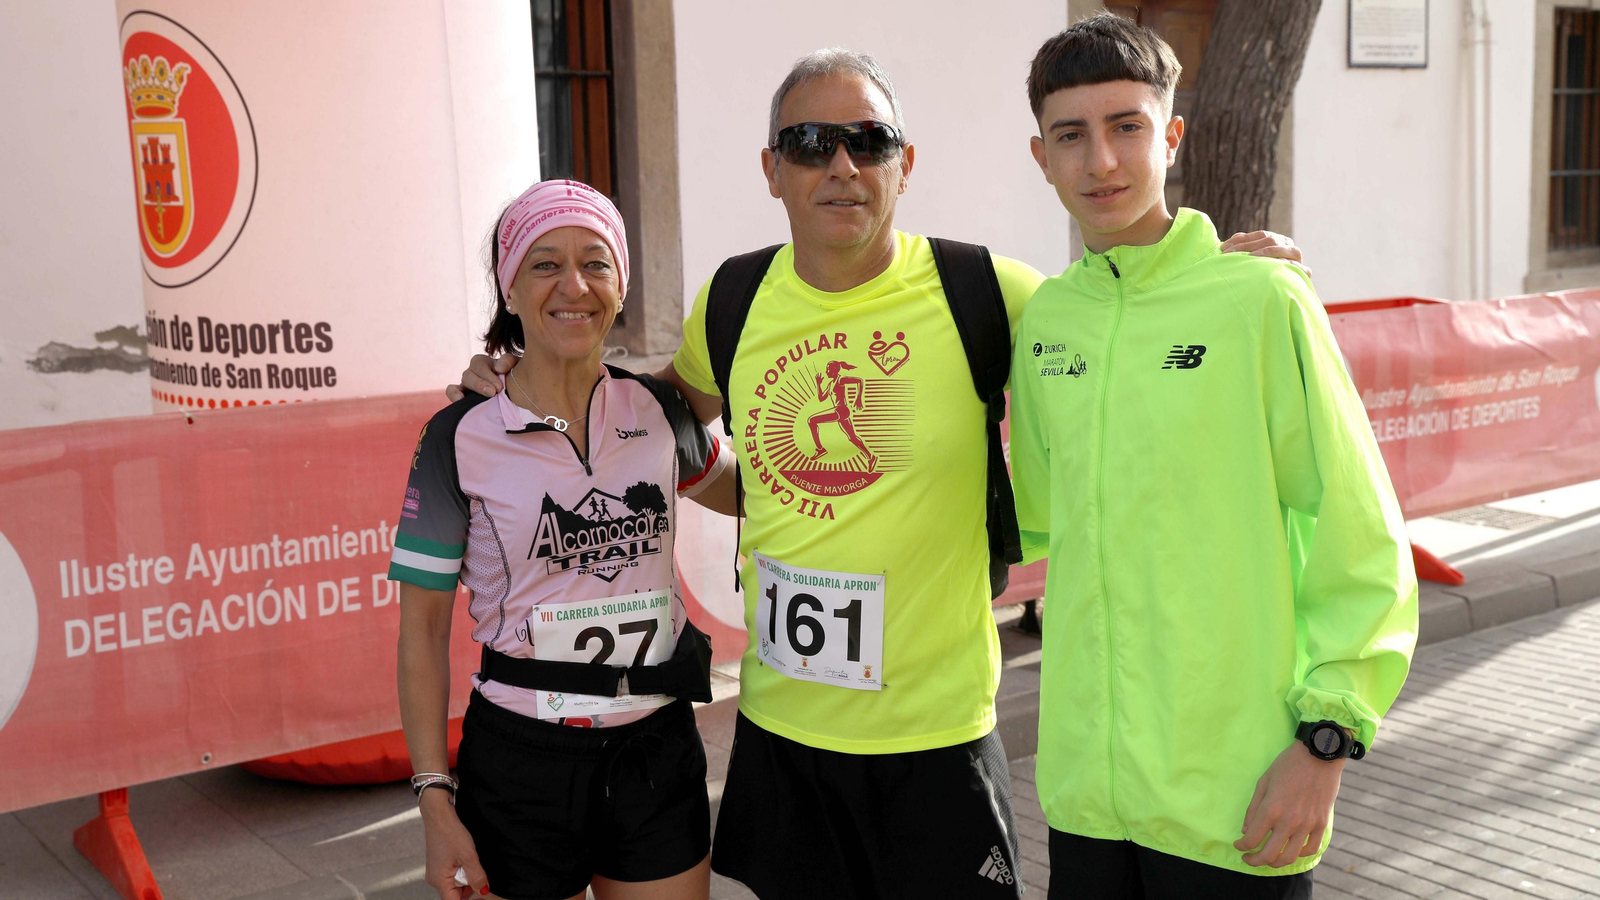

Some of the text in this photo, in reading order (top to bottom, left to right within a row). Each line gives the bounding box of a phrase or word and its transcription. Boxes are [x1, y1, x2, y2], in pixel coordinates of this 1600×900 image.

[170, 314, 194, 352] de
[197, 315, 334, 358] Deportes
[1044, 344, 1066, 354] ZURICH
[201, 362, 222, 388] de
[226, 362, 263, 389] San
[268, 364, 337, 391] Roque
[1040, 367, 1064, 377] SEVILLA
[1407, 370, 1496, 409] Ayuntamiento
[1498, 370, 1516, 391] de
[1516, 368, 1541, 389] San
[1542, 364, 1581, 387] Roque
[745, 332, 848, 520] VII CARRERA POPULAR
[1452, 406, 1470, 431] DE
[1472, 395, 1542, 428] DEPORTES
[789, 473, 868, 494] PUENTE MAYORGA
[552, 540, 659, 570] TRAIL
[578, 562, 639, 576] RUNNING
[59, 553, 176, 598] Ilustre
[758, 558, 877, 592] VII CARRERA SOLIDARIA APRON
[64, 580, 308, 658] DELEGACIÓN
[318, 577, 362, 617] DE
[541, 611, 553, 622] VII
[556, 606, 600, 622] CARRERA
[602, 602, 648, 616] SOLIDARIA
[766, 582, 862, 662] 161
[574, 618, 658, 667] 27
[990, 845, 1014, 885] adidas
